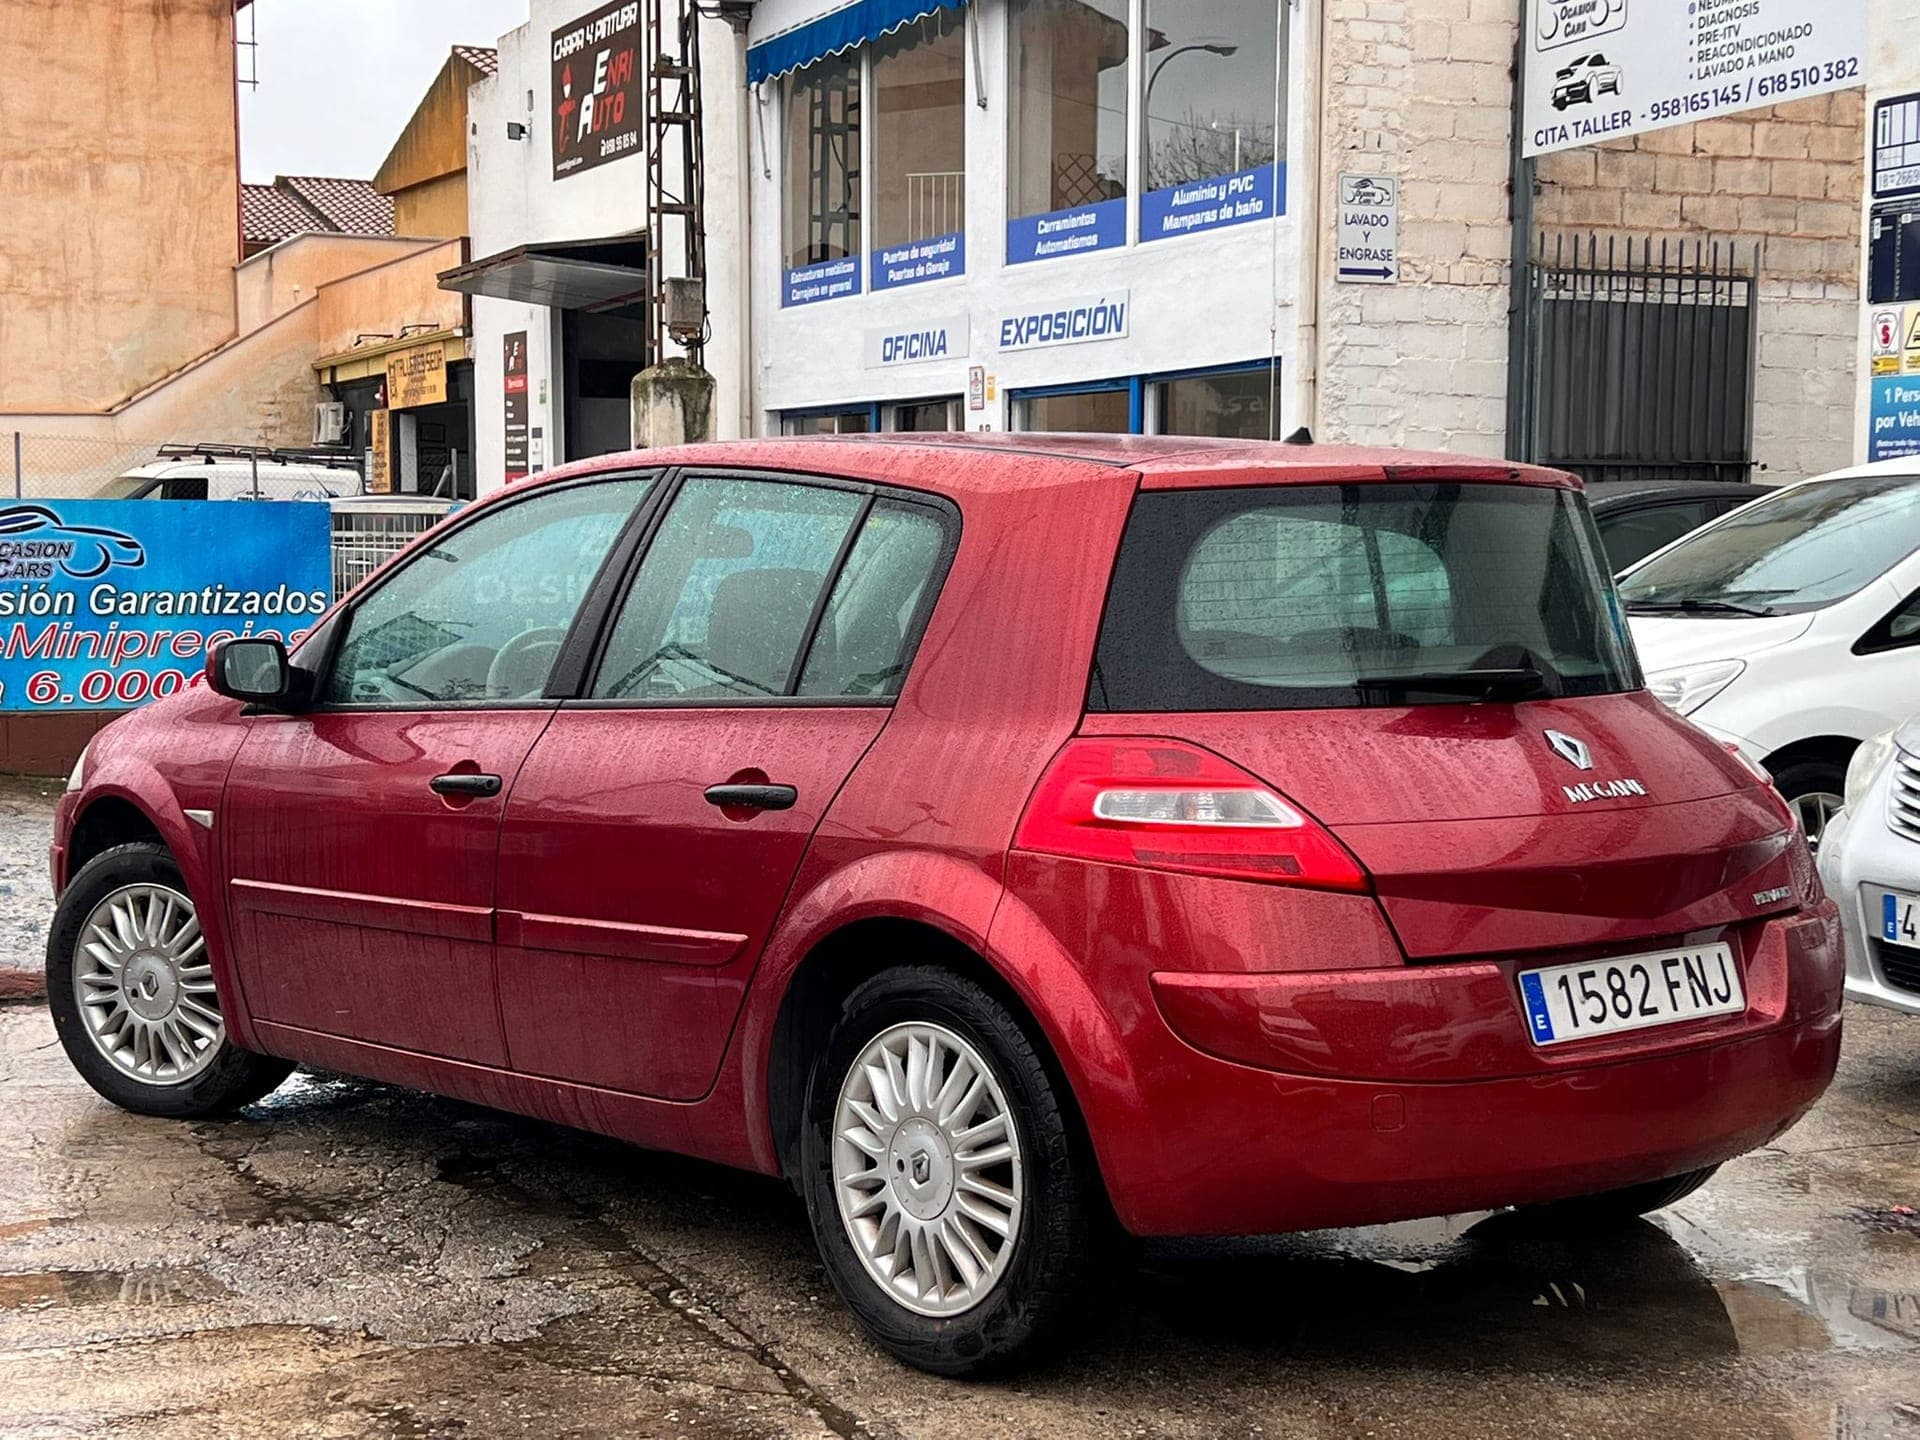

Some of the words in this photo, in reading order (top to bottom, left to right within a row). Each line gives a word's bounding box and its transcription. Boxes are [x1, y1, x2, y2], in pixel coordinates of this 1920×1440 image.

[1560, 0, 1597, 19] OCASION
[1698, 1, 1760, 30] DIAGNOSIS
[553, 28, 585, 61] CHAPA
[595, 2, 638, 42] PINTURA
[1564, 20, 1587, 38] CARS
[1697, 23, 1741, 46] PRE-ITV
[1697, 22, 1813, 63] REACONDICIONADO
[593, 48, 634, 96] ENRI
[1697, 57, 1744, 80] LAVADO
[1747, 54, 1755, 68] A
[1758, 45, 1795, 66] MANO
[577, 91, 625, 143] AUTO
[1534, 124, 1569, 147] CITA
[1572, 110, 1632, 139] TALLER
[1172, 187, 1217, 207] Aluminio
[1219, 184, 1226, 200] y
[1229, 175, 1255, 195] PVC
[1037, 212, 1096, 235] Cerramientos
[1163, 211, 1217, 232] Mamparas
[1219, 205, 1233, 219] de
[1235, 198, 1263, 216] baño
[1345, 213, 1389, 227] LAVADO
[1034, 233, 1098, 256] Automatismos
[1362, 231, 1371, 243] Y
[882, 250, 909, 266] Puertas
[910, 245, 919, 260] de
[920, 236, 956, 259] seguridad
[1339, 247, 1393, 261] ENGRASE
[790, 269, 824, 285] Estructuras
[825, 262, 855, 277] metálicas
[887, 267, 915, 282] Puertas
[915, 263, 925, 277] de
[926, 258, 950, 276] Garaje
[820, 285, 829, 296] en
[828, 277, 853, 297] general
[1000, 298, 1125, 347] EXPOSICIÓN
[882, 329, 947, 362] OFICINA
[1884, 388, 1891, 404] 1
[1875, 415, 1896, 433] por
[0, 559, 52, 577] CARS
[0, 584, 75, 616] sión
[90, 584, 326, 616] Garantizados
[1888, 921, 1895, 933] E
[1902, 904, 1917, 941] 4
[1558, 964, 1658, 1027] 1582
[1661, 952, 1732, 1011] FNJ
[1535, 1014, 1547, 1030] E
